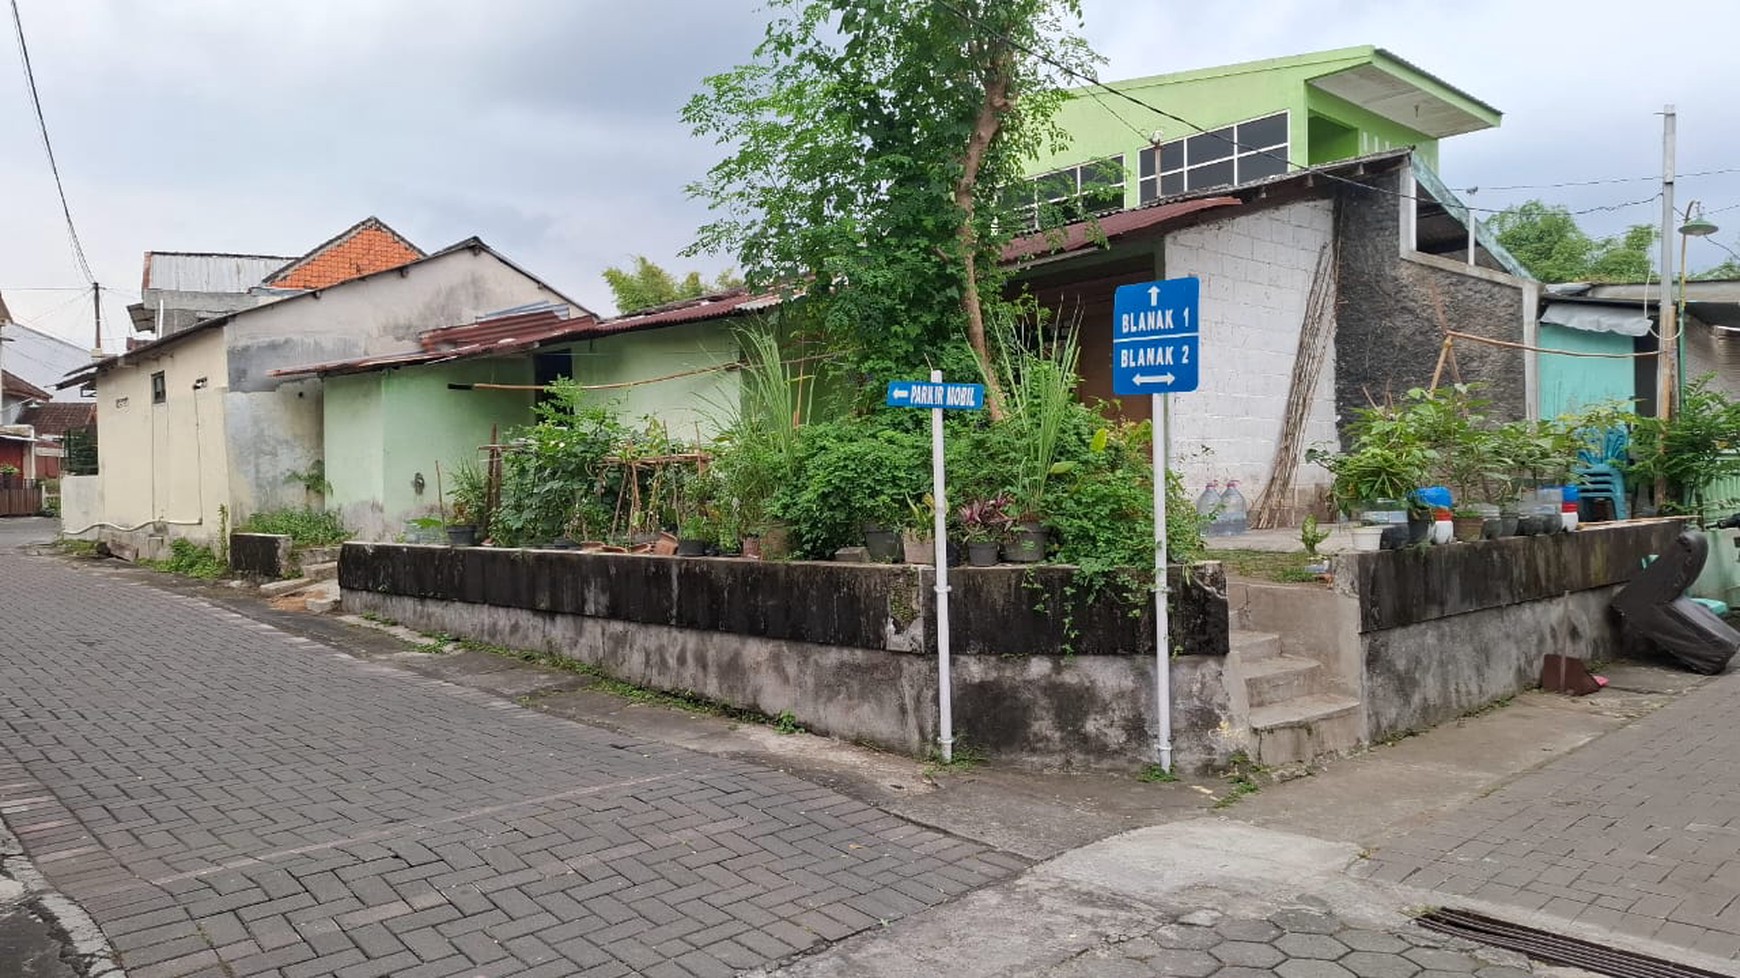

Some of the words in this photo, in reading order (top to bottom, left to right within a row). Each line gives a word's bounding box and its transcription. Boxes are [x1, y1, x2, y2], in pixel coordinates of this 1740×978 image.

[1122, 309, 1174, 333] BLANAK
[1183, 306, 1189, 327] 1
[1121, 346, 1174, 368] BLANAK
[1182, 345, 1189, 364] 2
[910, 385, 944, 405] PARKIR
[946, 386, 975, 406] MOBIL
